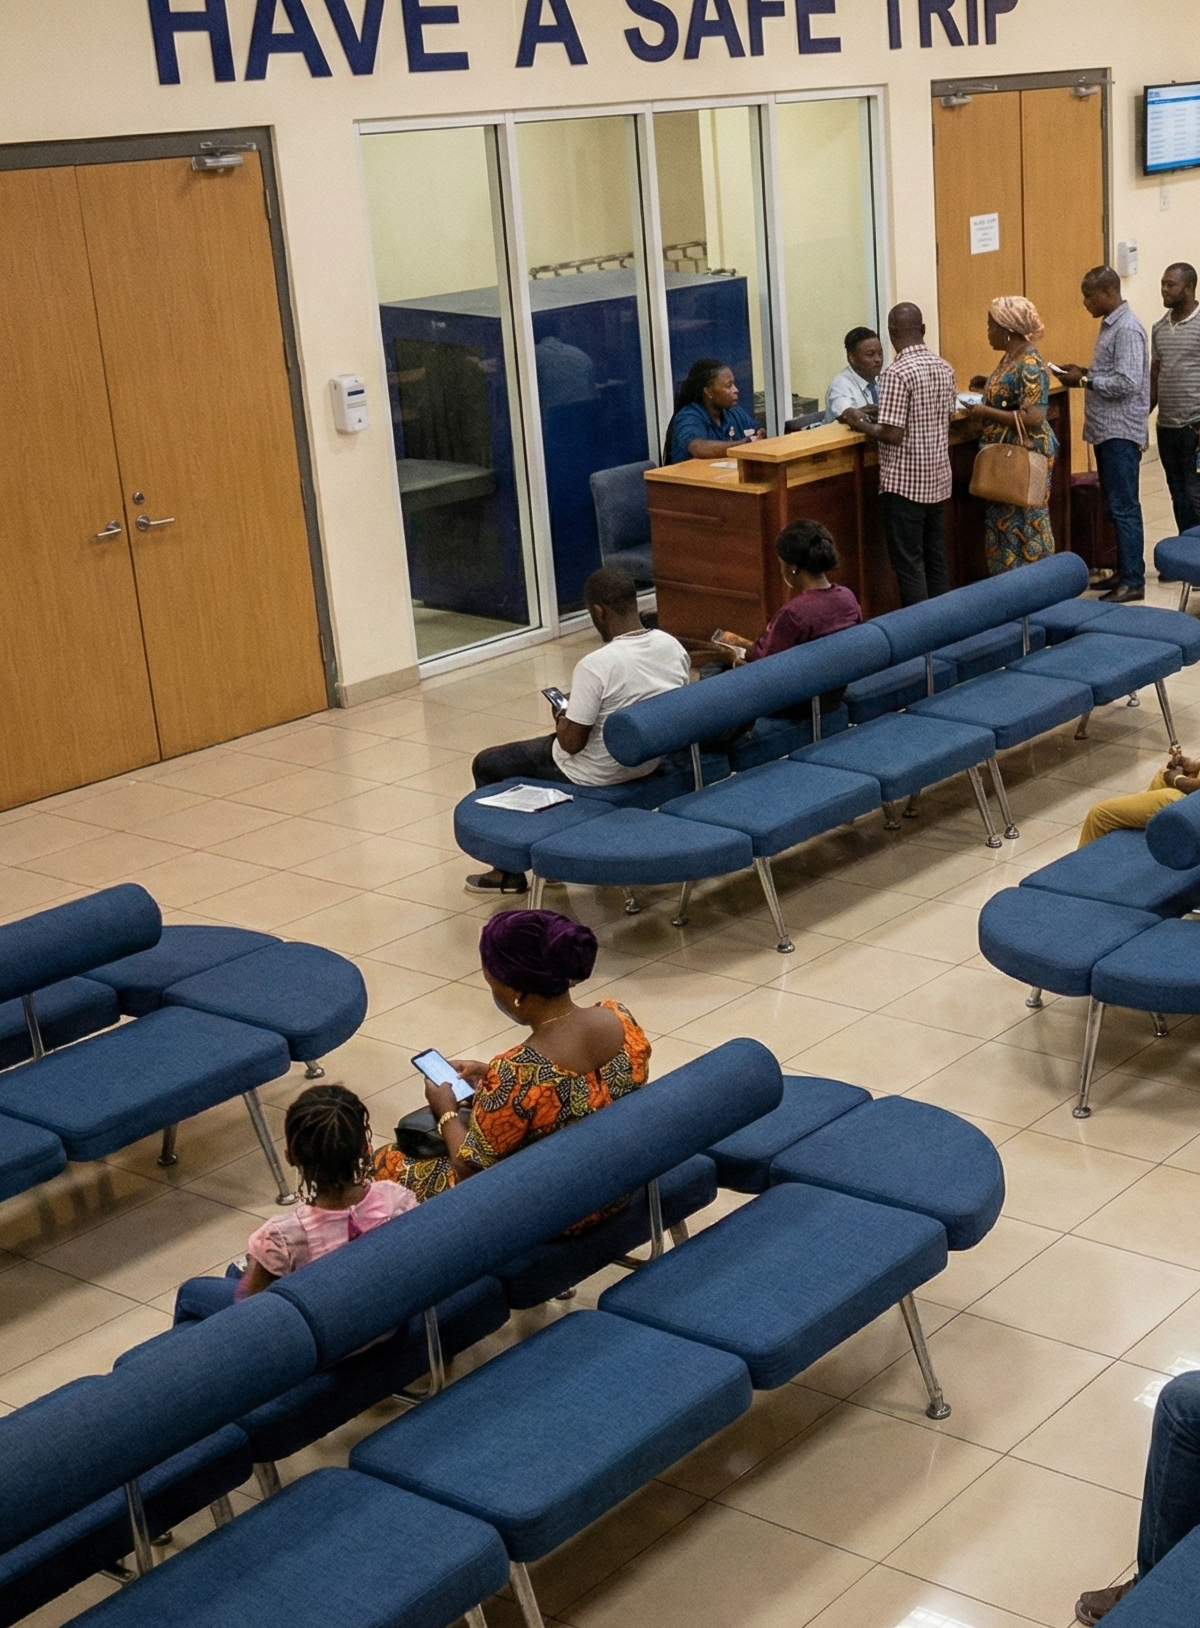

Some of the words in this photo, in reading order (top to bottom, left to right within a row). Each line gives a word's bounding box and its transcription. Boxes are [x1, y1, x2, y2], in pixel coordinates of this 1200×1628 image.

[147, 0, 470, 85] HAVE
[515, 0, 588, 68] A
[624, 0, 842, 62] SAFE
